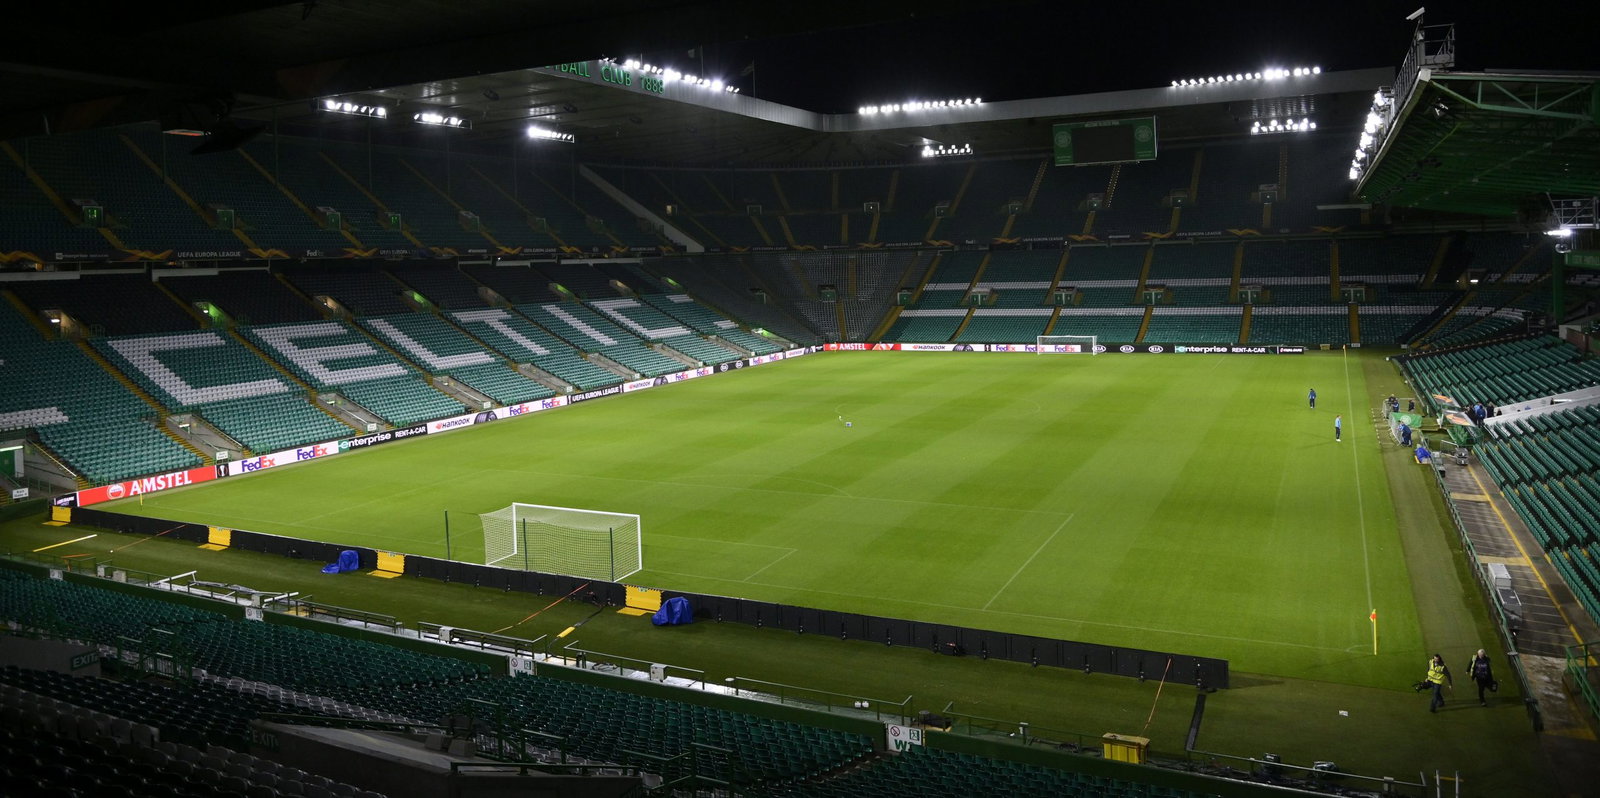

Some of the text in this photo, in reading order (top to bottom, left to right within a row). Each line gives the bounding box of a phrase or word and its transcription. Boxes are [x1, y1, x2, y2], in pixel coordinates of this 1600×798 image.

[602, 65, 632, 86] CLUB
[641, 75, 665, 94] 1888
[996, 344, 1016, 352] FedEx
[1179, 345, 1227, 353] enterprise
[585, 391, 602, 400] EUROPA
[603, 386, 619, 396] LEAGUE
[509, 403, 530, 417] FedEx
[542, 397, 560, 410] FedEx
[340, 426, 426, 449] enterprise RENT-A-CAR
[297, 445, 328, 461] FedEx
[241, 455, 276, 473] FedEx
[129, 470, 192, 496] AMSTEL
[73, 652, 96, 668] EXIT
